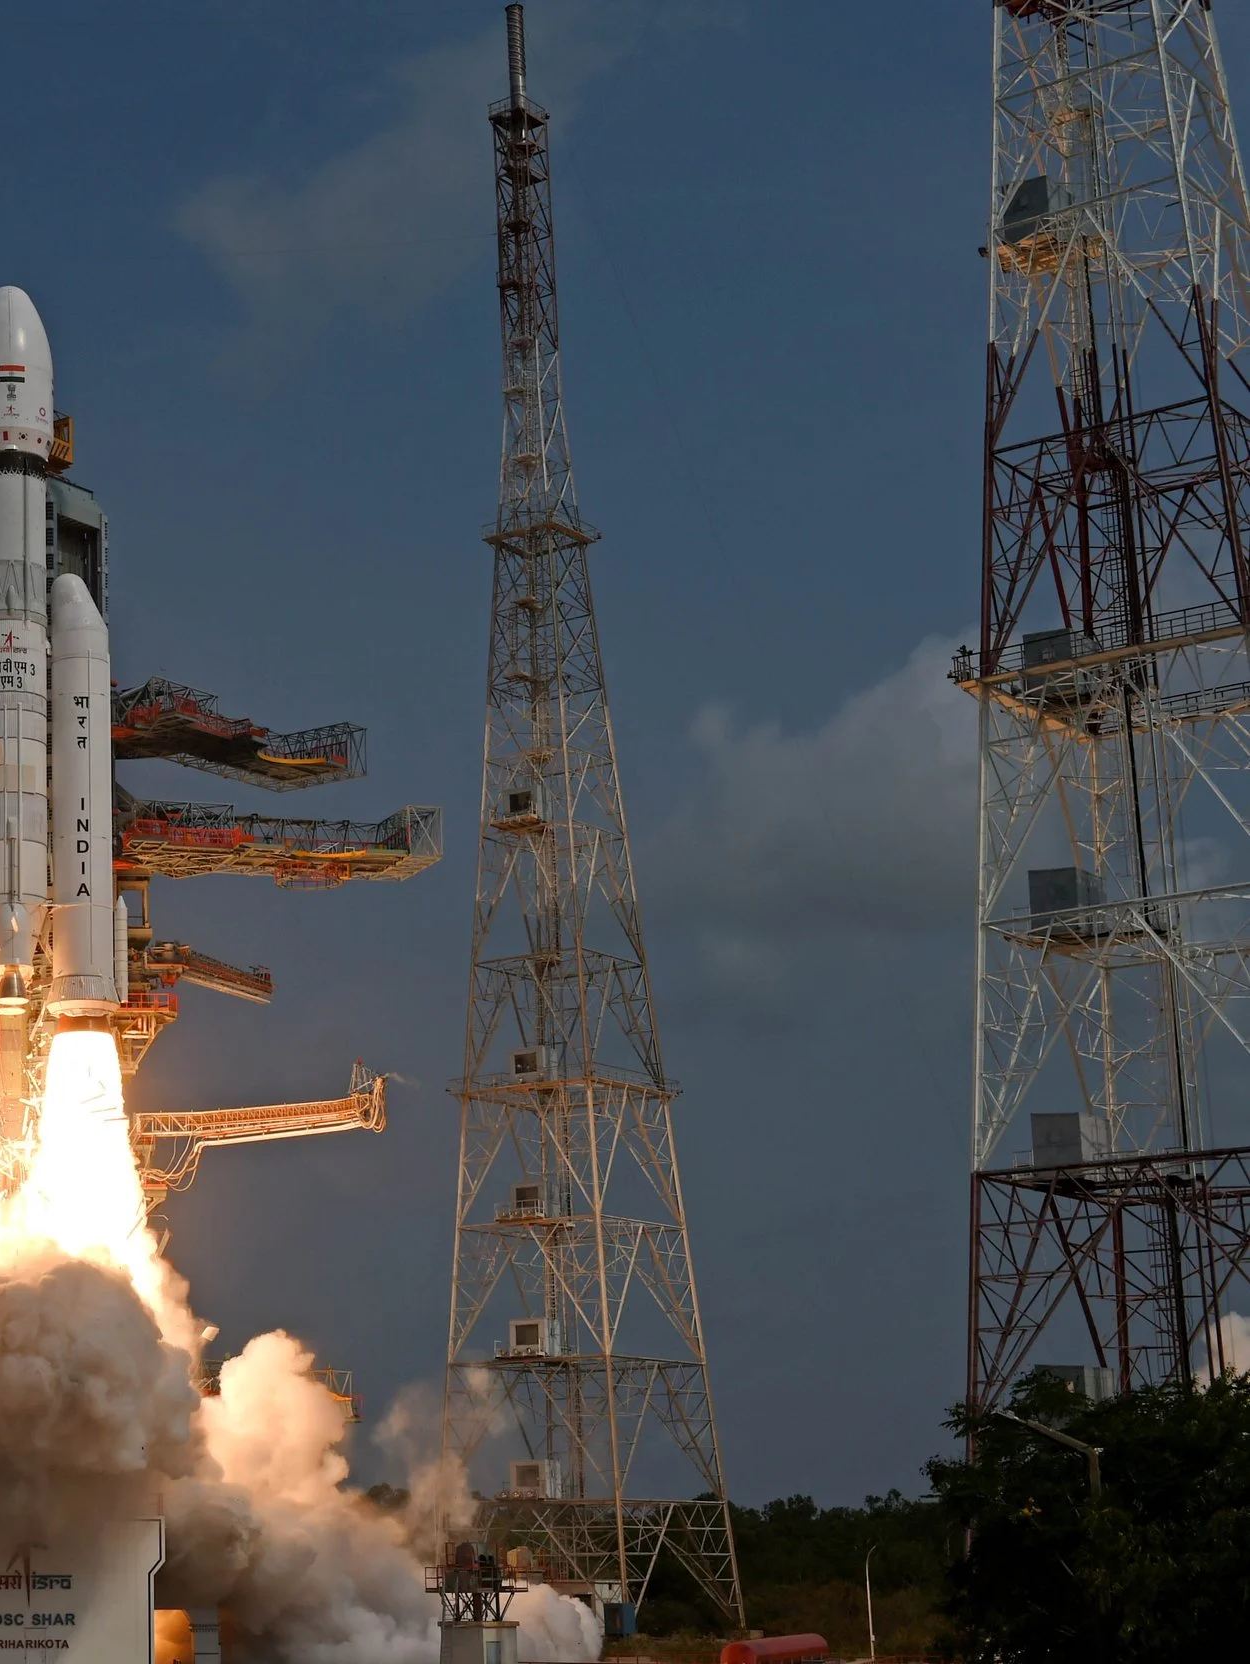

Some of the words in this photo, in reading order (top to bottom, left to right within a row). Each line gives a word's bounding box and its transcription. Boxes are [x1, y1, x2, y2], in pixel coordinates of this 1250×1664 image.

[0, 675, 14, 690] एम
[16, 676, 23, 689] 3
[76, 797, 91, 897] INDIA
[31, 1613, 76, 1626] SHAR
